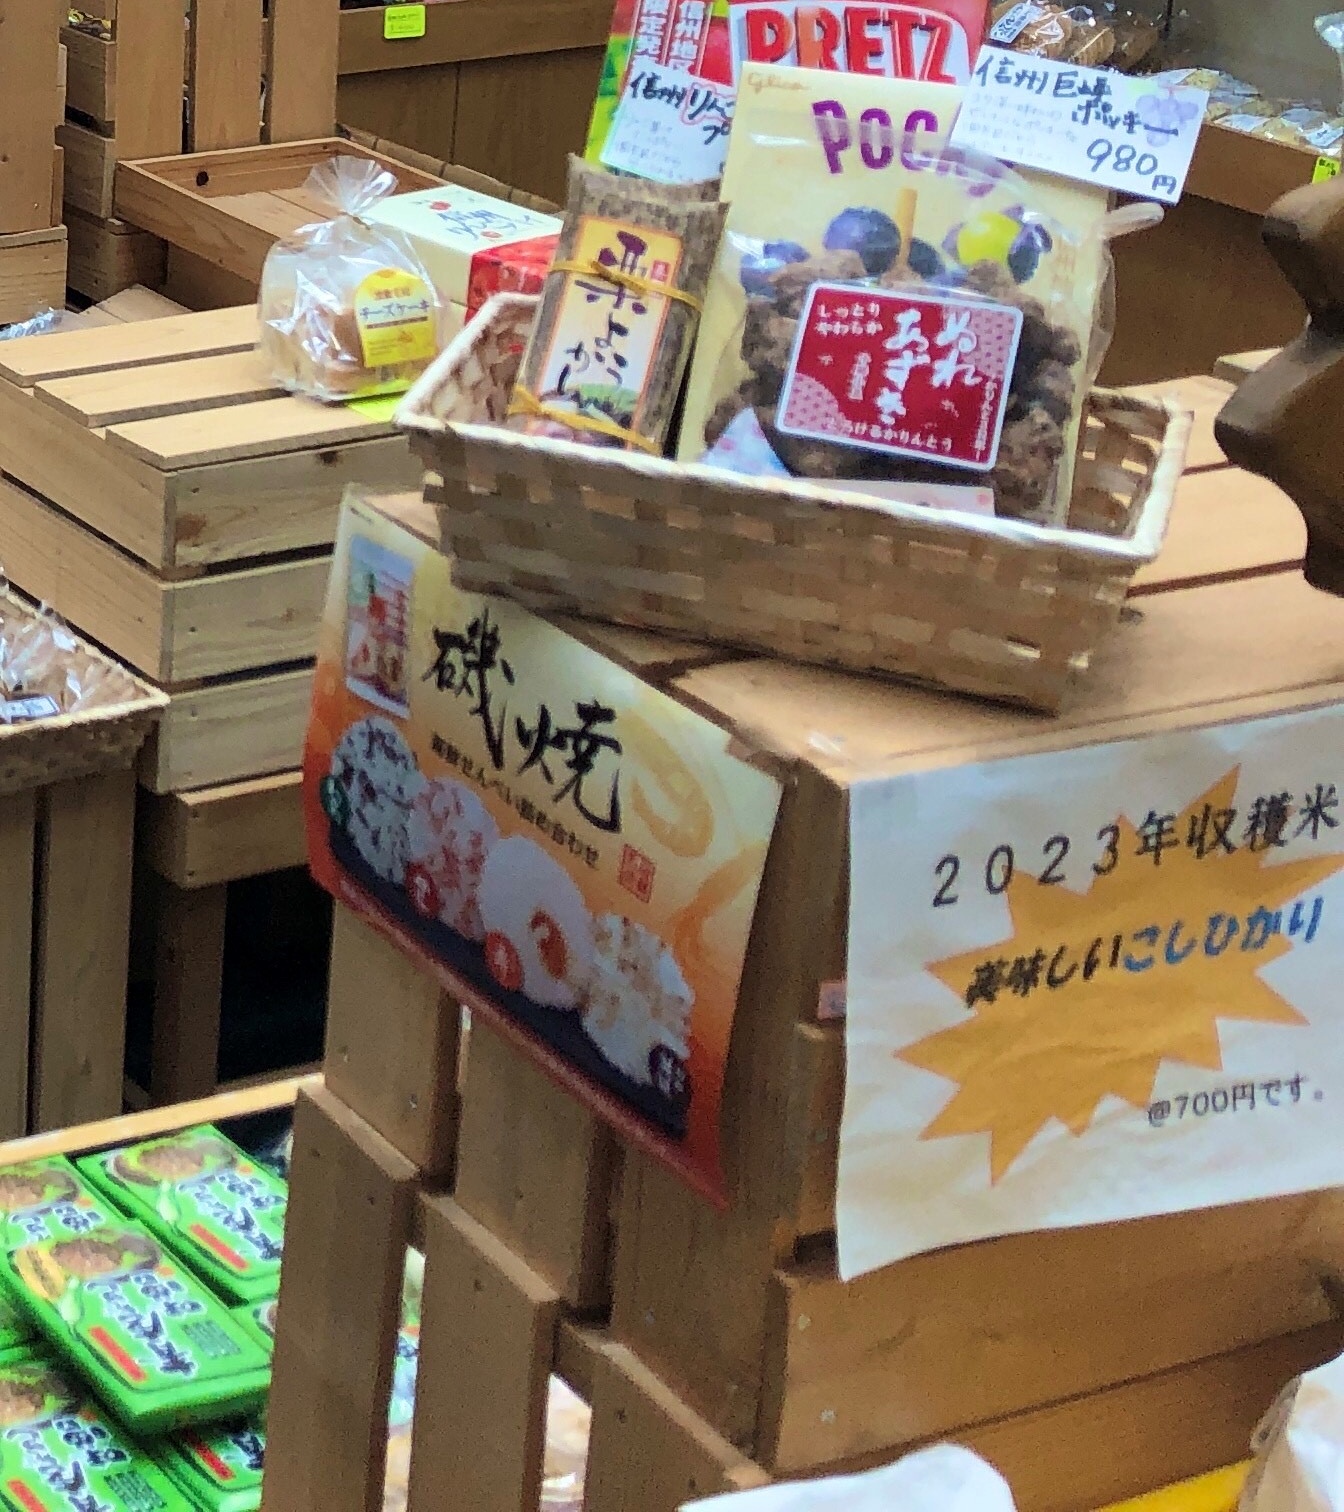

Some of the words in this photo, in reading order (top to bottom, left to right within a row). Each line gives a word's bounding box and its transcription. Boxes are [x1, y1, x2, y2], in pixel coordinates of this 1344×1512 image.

[744, 5, 958, 85] PRETZ
[816, 302, 881, 319] しっとり
[934, 310, 984, 388] ぬれ
[875, 307, 932, 425] あずき
[931, 782, 1342, 908] 2023年収穫米
[965, 895, 1325, 1008] 美味しいこしひかり
